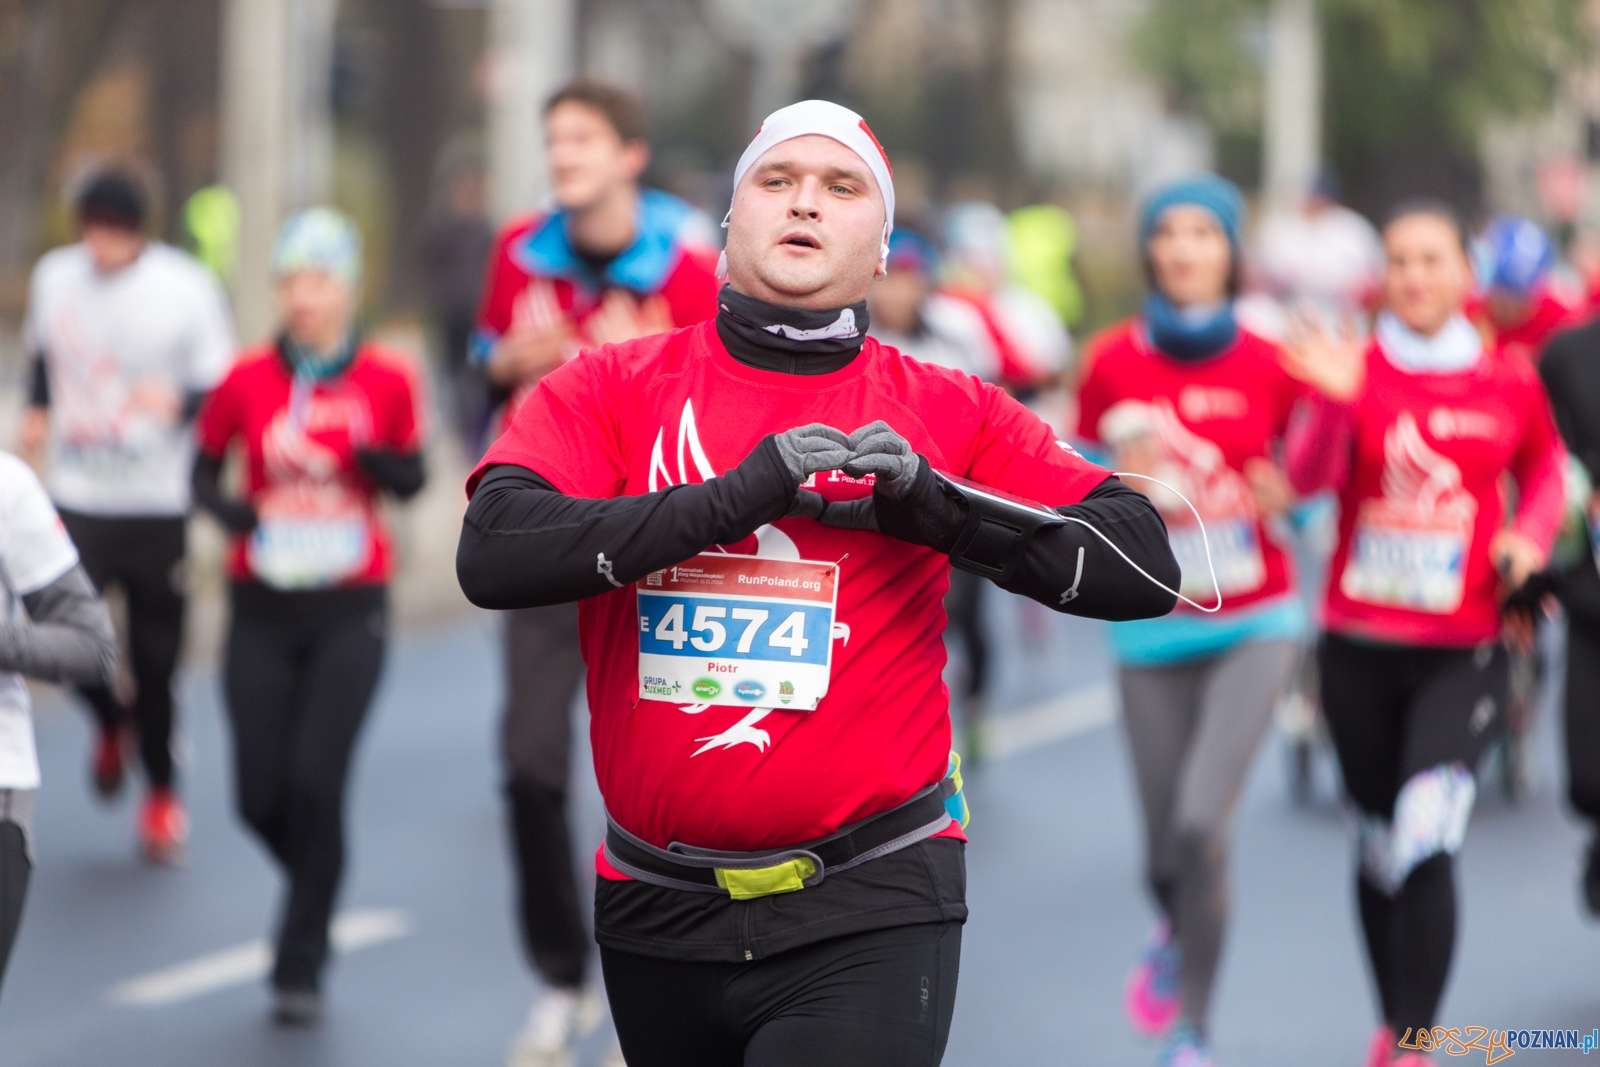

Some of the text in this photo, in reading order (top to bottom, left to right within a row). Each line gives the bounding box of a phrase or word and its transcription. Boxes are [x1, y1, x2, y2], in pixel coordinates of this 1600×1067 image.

[670, 566, 679, 582] 1
[737, 574, 821, 592] RunPoland.org
[640, 603, 809, 657] E 4574
[707, 662, 739, 674] Piotr
[644, 676, 667, 686] GRUPA
[696, 685, 719, 695] energy
